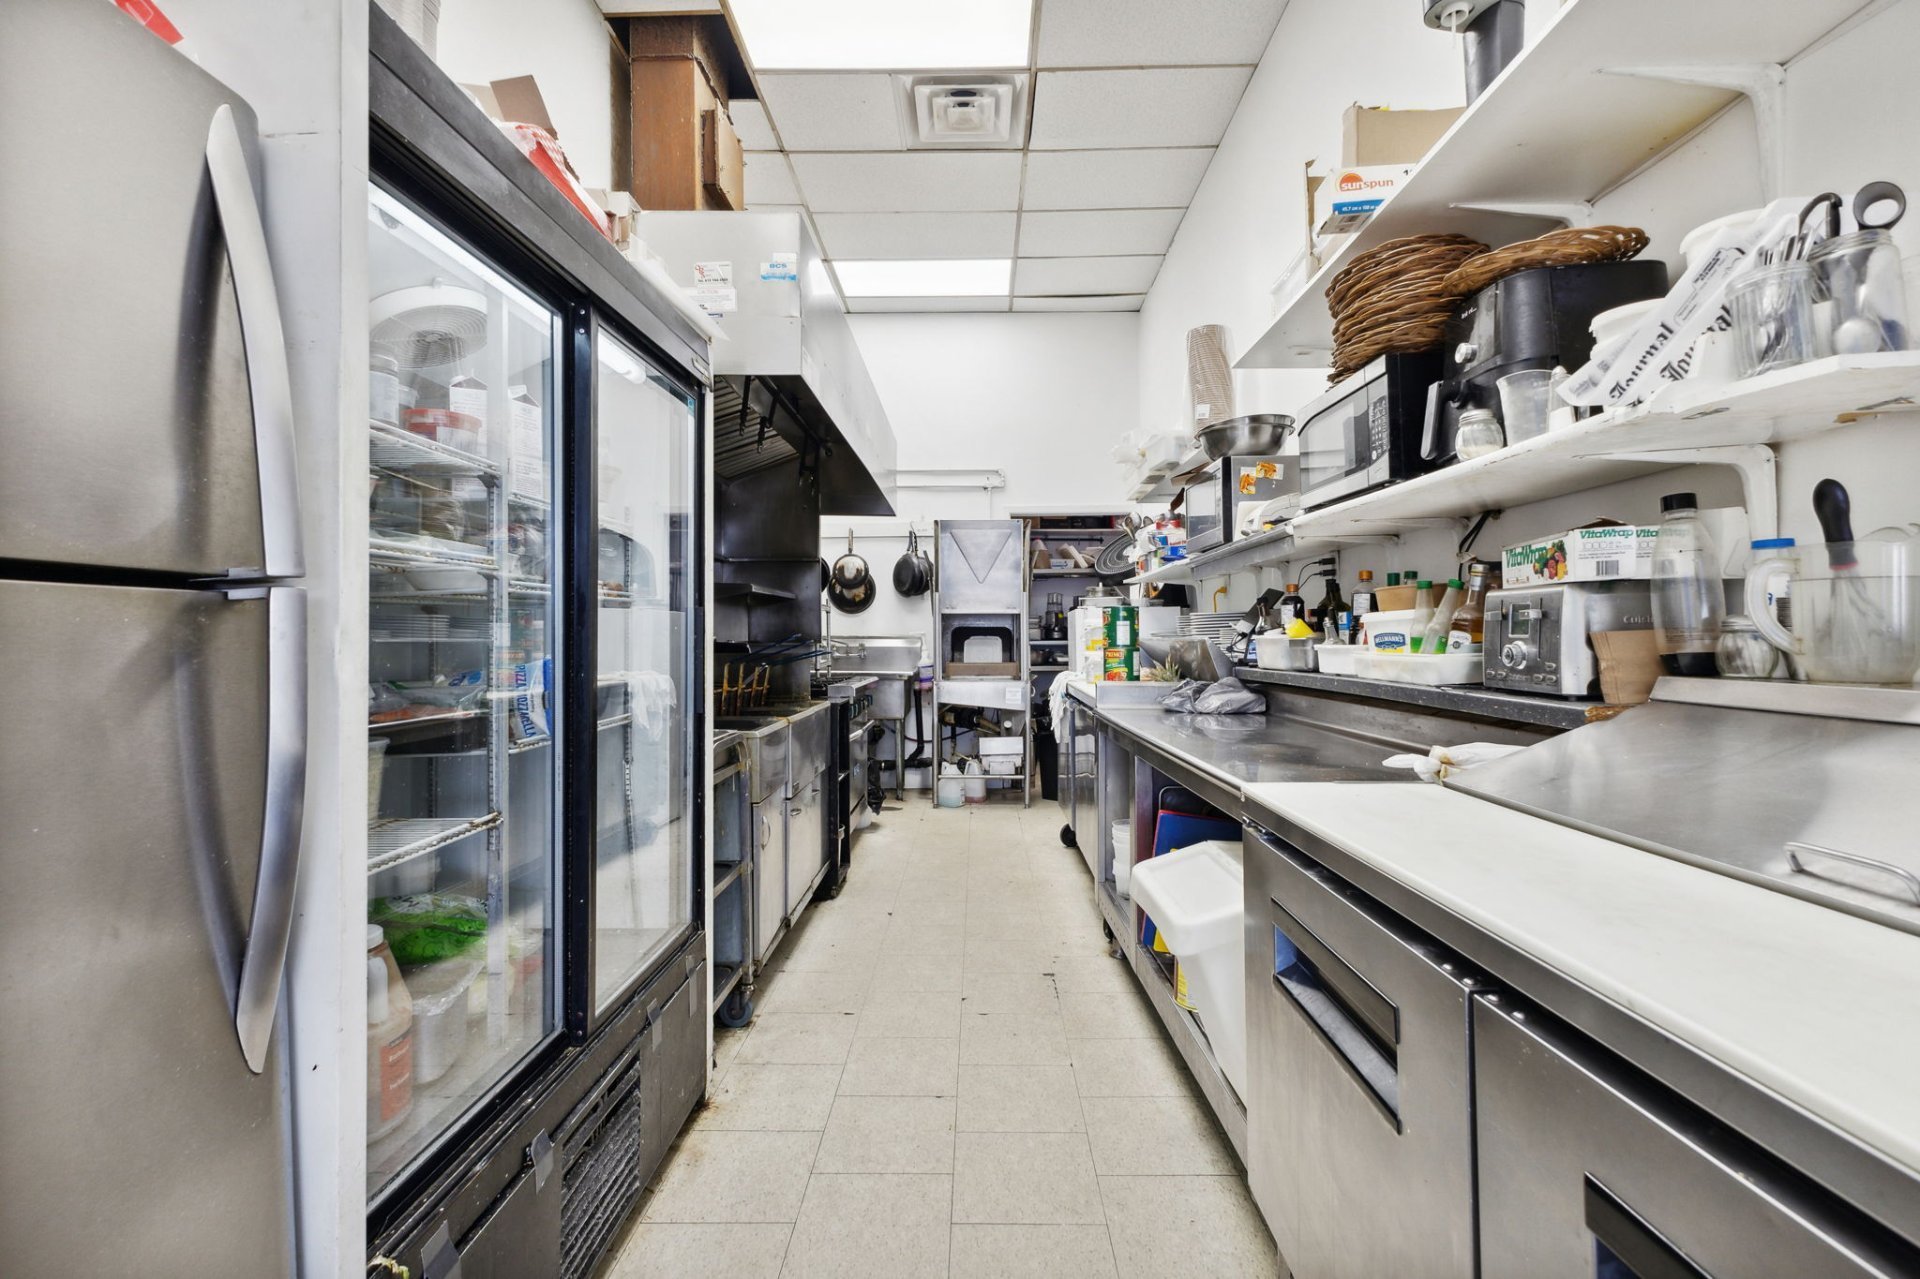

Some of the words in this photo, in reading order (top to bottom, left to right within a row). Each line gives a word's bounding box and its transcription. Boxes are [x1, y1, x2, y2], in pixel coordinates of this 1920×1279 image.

[1341, 180, 1393, 190] sunspun
[1609, 321, 1674, 399] Journal
[1580, 528, 1634, 539] VitaWrap
[514, 664, 527, 688] PIZZA
